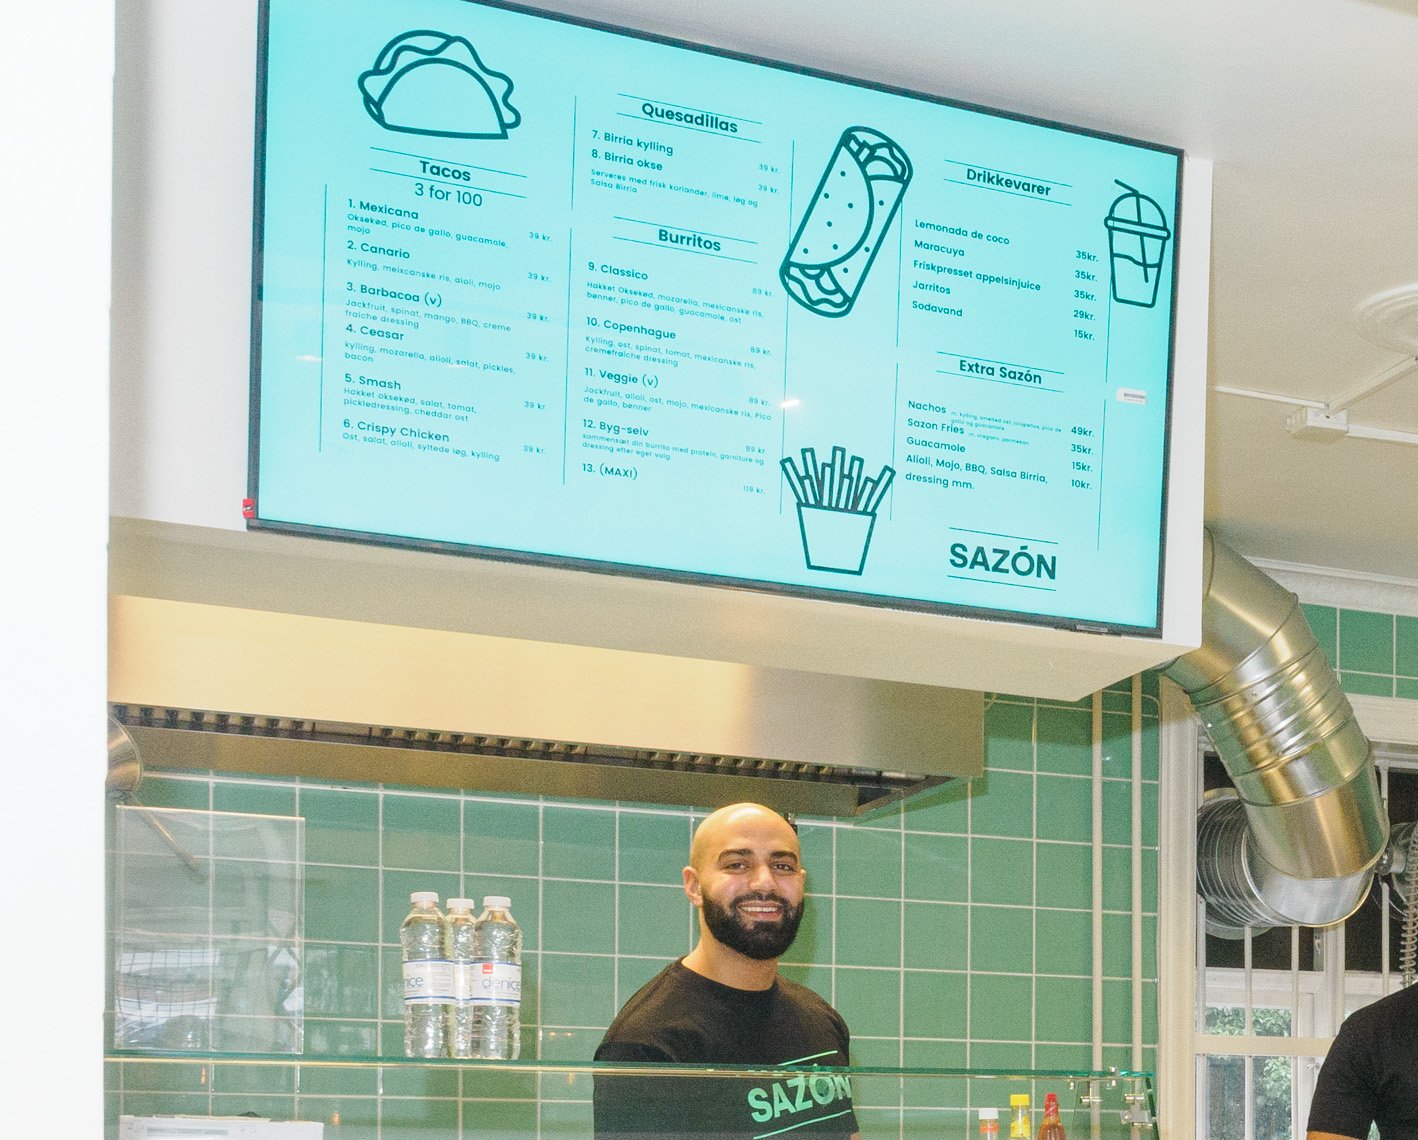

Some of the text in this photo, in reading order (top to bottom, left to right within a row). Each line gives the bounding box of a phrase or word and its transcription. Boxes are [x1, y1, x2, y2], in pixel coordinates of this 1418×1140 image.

[641, 102, 738, 133] Quesadillas
[592, 129, 673, 156] 7. Birria kylling
[591, 148, 663, 171] 8. Birria okse
[419, 160, 471, 181] Tacos
[966, 168, 1051, 196] Drikkevarer
[414, 182, 482, 207] 3 for 100
[348, 198, 418, 219] 1. Mexicana
[658, 228, 721, 251] Burritos
[915, 219, 1010, 245] Lemonada de coco
[347, 239, 410, 259] 2. Canario
[914, 239, 965, 257] Maracuya
[1075, 250, 1098, 262] 35kr.
[588, 261, 648, 280] 9. Classico
[913, 259, 1041, 291] Friskpresset appelsinjuice
[1075, 269, 1097, 281] 35kr.
[346, 281, 442, 308] 3. Barbacoa (v)
[912, 280, 951, 295] Jarritos
[1074, 289, 1097, 301] 35kr.
[912, 300, 963, 317] Sodavand
[1073, 309, 1096, 320] 29kr.
[345, 323, 404, 340] 4. Ceasar
[587, 316, 676, 340] 10. Copenhague
[1074, 329, 1095, 340] 15kr.
[584, 367, 659, 388] 11. Veggie (v)
[959, 359, 1042, 384] Extra Sazón
[345, 373, 401, 390] 5. Smash
[908, 400, 946, 414] Nachos
[343, 418, 449, 442] 6. Crispy Chicken
[583, 418, 649, 436] 12. Byg-selv
[907, 418, 938, 430] Sazon
[941, 423, 964, 435] Fries
[1071, 426, 1094, 436] 49kr.
[906, 436, 966, 453] Guacamole
[1071, 443, 1093, 454] 35kr.
[582, 463, 638, 480] 13. (MAXI)
[935, 458, 962, 471] Mojo,
[965, 462, 987, 475] BBQ,
[990, 466, 1017, 478] Salsa
[1020, 471, 1047, 484] Birria,
[1072, 461, 1093, 471] 15kr.
[905, 472, 974, 489] dressing mm.
[1071, 479, 1092, 489] 10kr.
[949, 543, 1056, 580] SAZÓN
